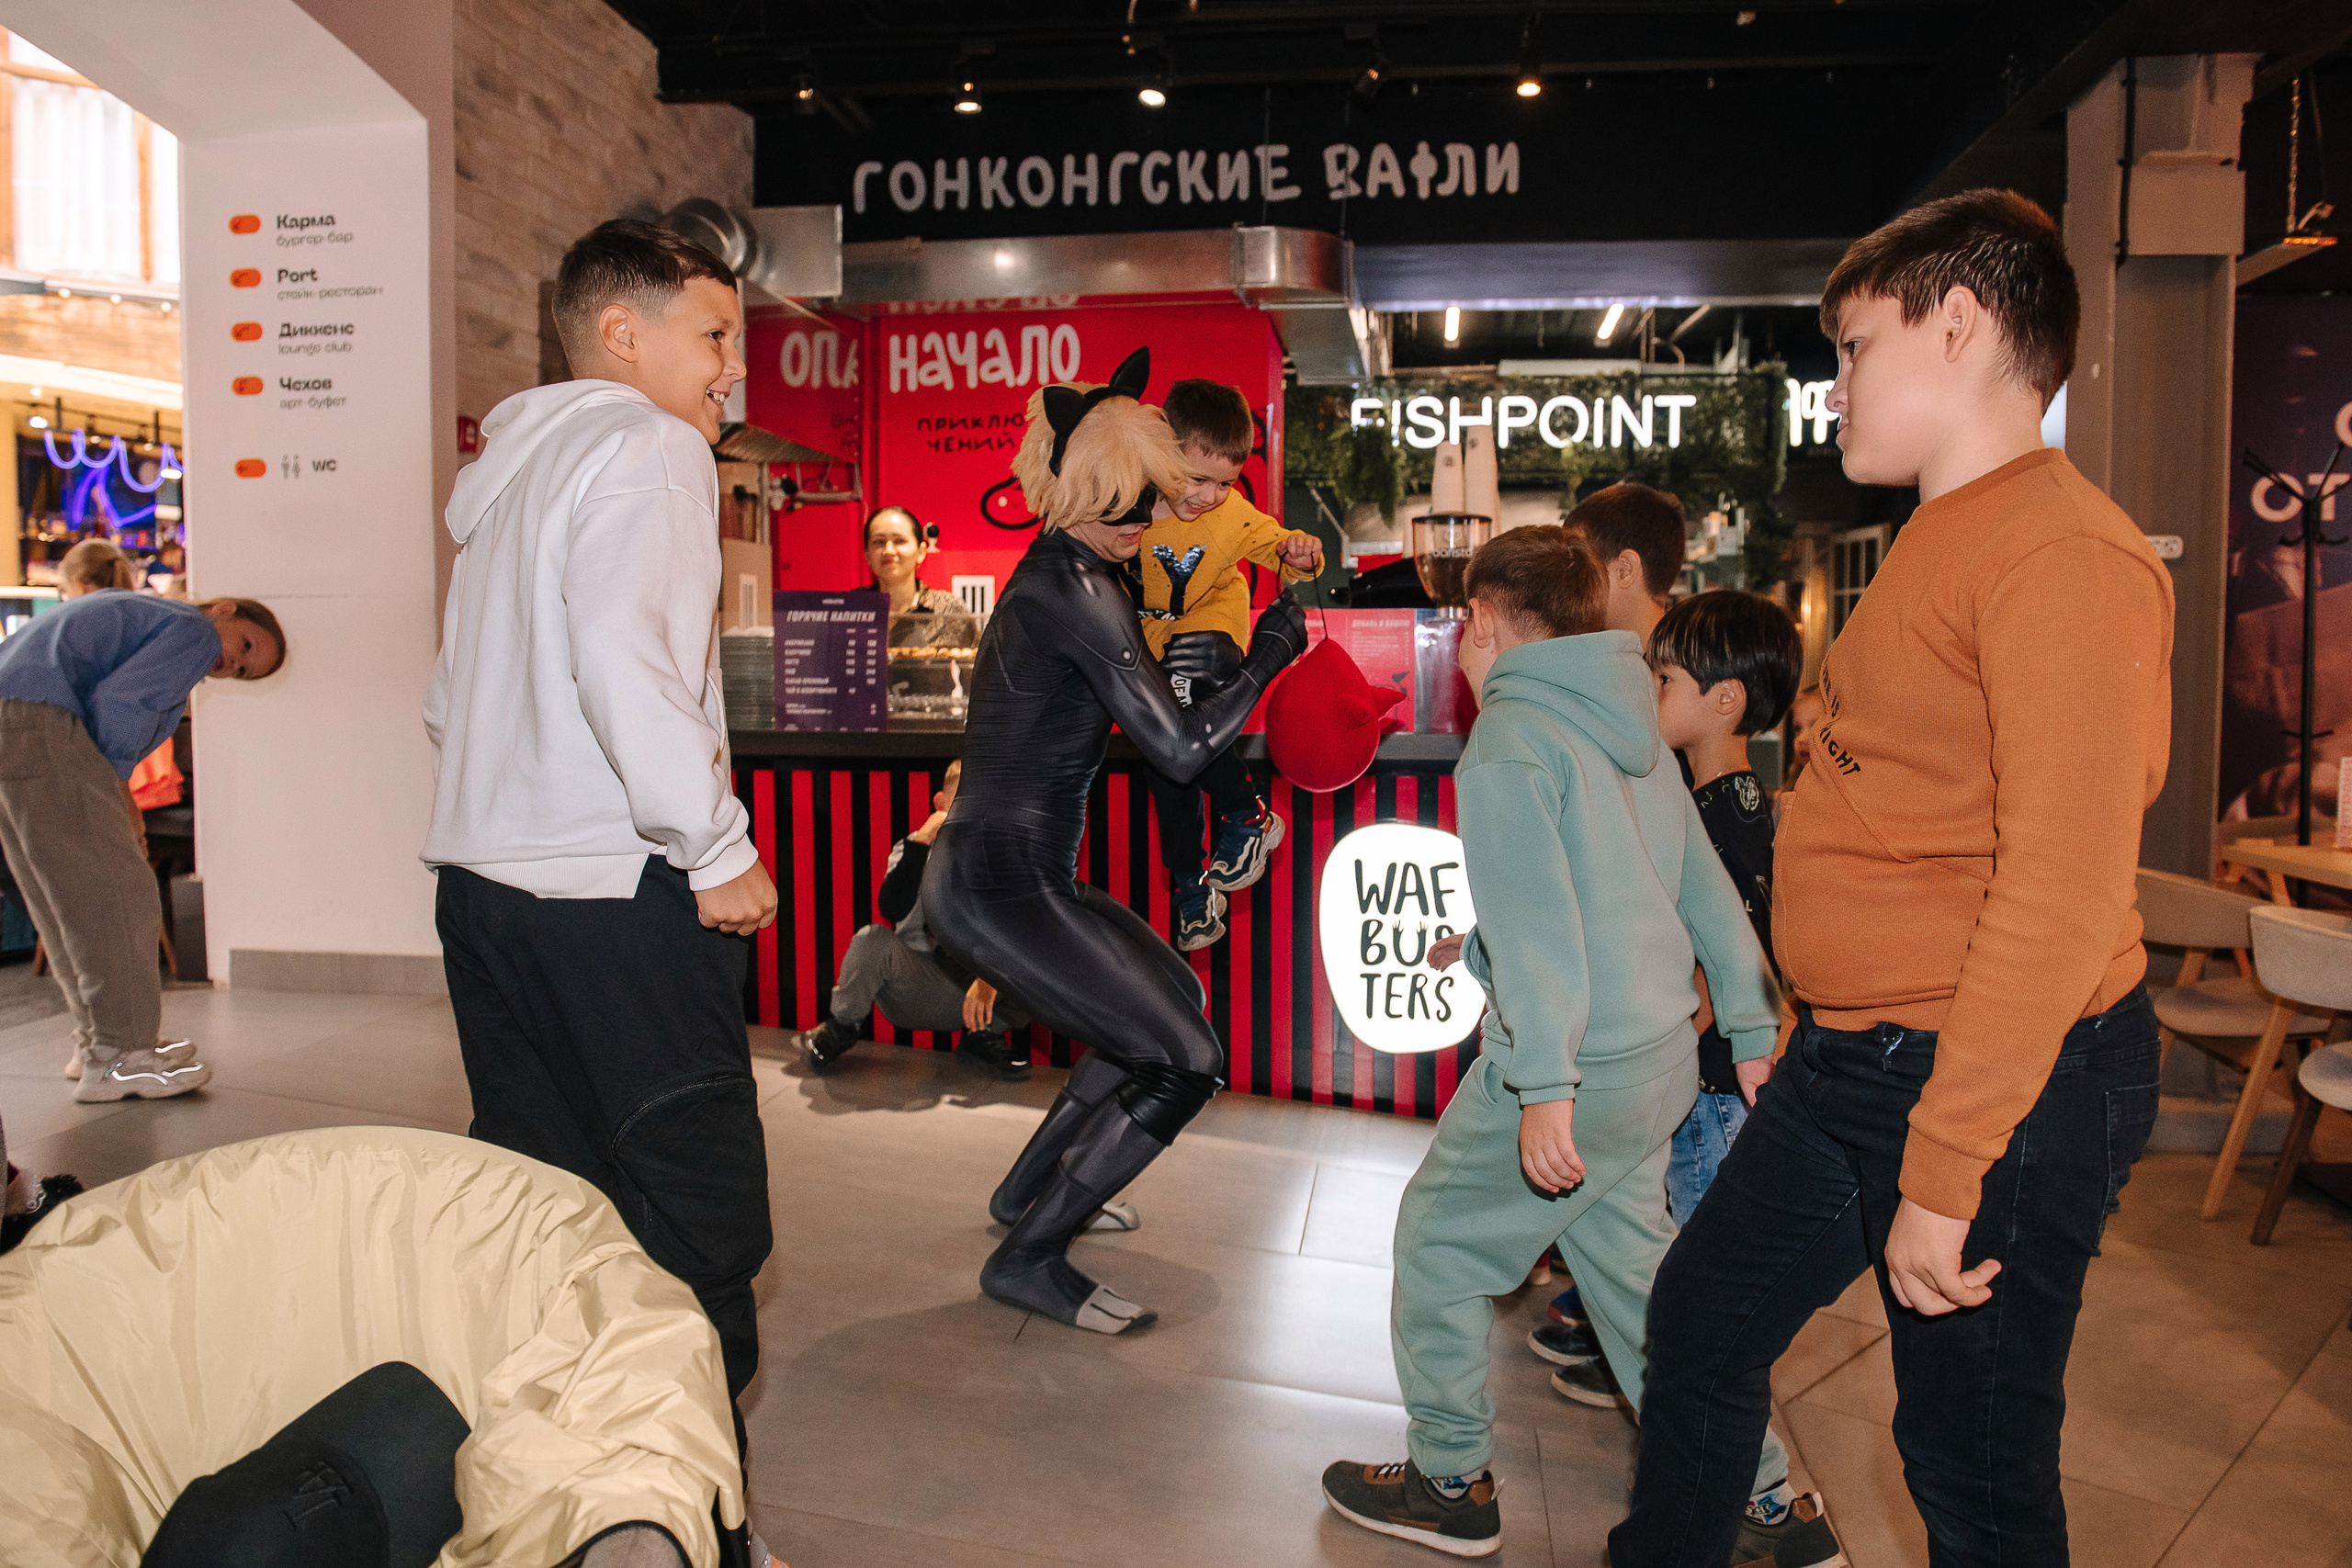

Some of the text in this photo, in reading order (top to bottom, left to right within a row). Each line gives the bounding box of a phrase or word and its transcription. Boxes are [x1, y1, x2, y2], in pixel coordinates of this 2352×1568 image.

[854, 141, 1521, 212] ГОНКОНГСКИЕ ВАФЛИ
[277, 214, 335, 231] Карма
[277, 267, 318, 283] Port
[278, 322, 355, 338] Диккенс
[324, 341, 353, 353] club
[279, 377, 333, 390] Чехов
[1351, 395, 1697, 449] FISHPOINT
[1354, 858, 1460, 919] WAF
[1360, 971, 1454, 1022] TERS
